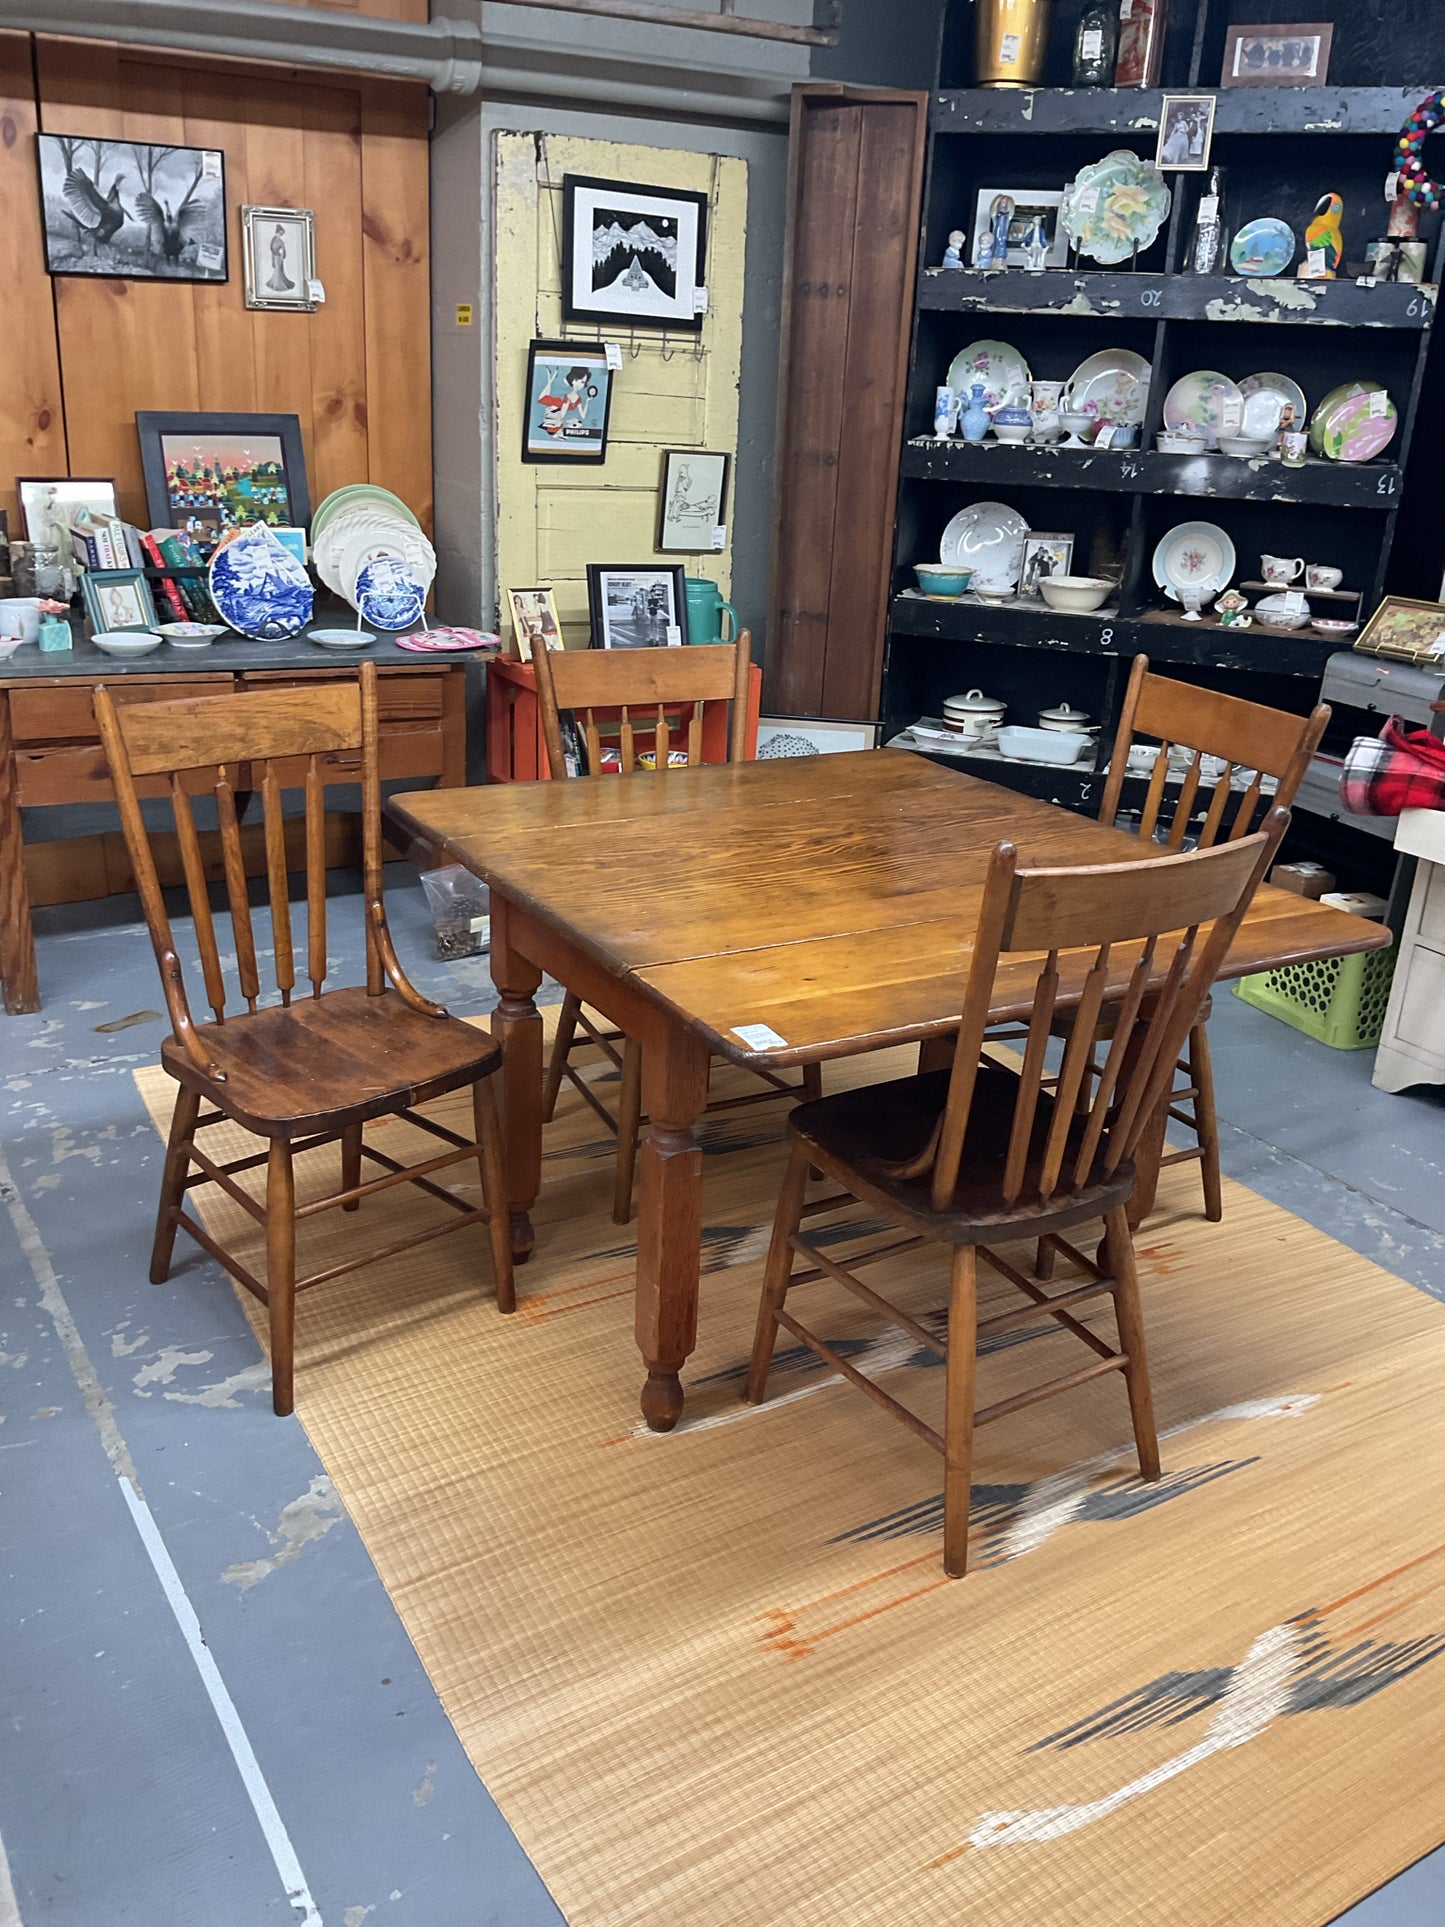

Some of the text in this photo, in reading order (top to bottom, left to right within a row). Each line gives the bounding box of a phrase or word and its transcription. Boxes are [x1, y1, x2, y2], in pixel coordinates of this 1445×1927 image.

[1140, 289, 1163, 307] 20
[1405, 298, 1429, 318] 19
[1120, 461, 1138, 479] 14
[1376, 474, 1396, 495] 13
[1099, 628, 1114, 646] 8
[1079, 782, 1092, 800] 2
